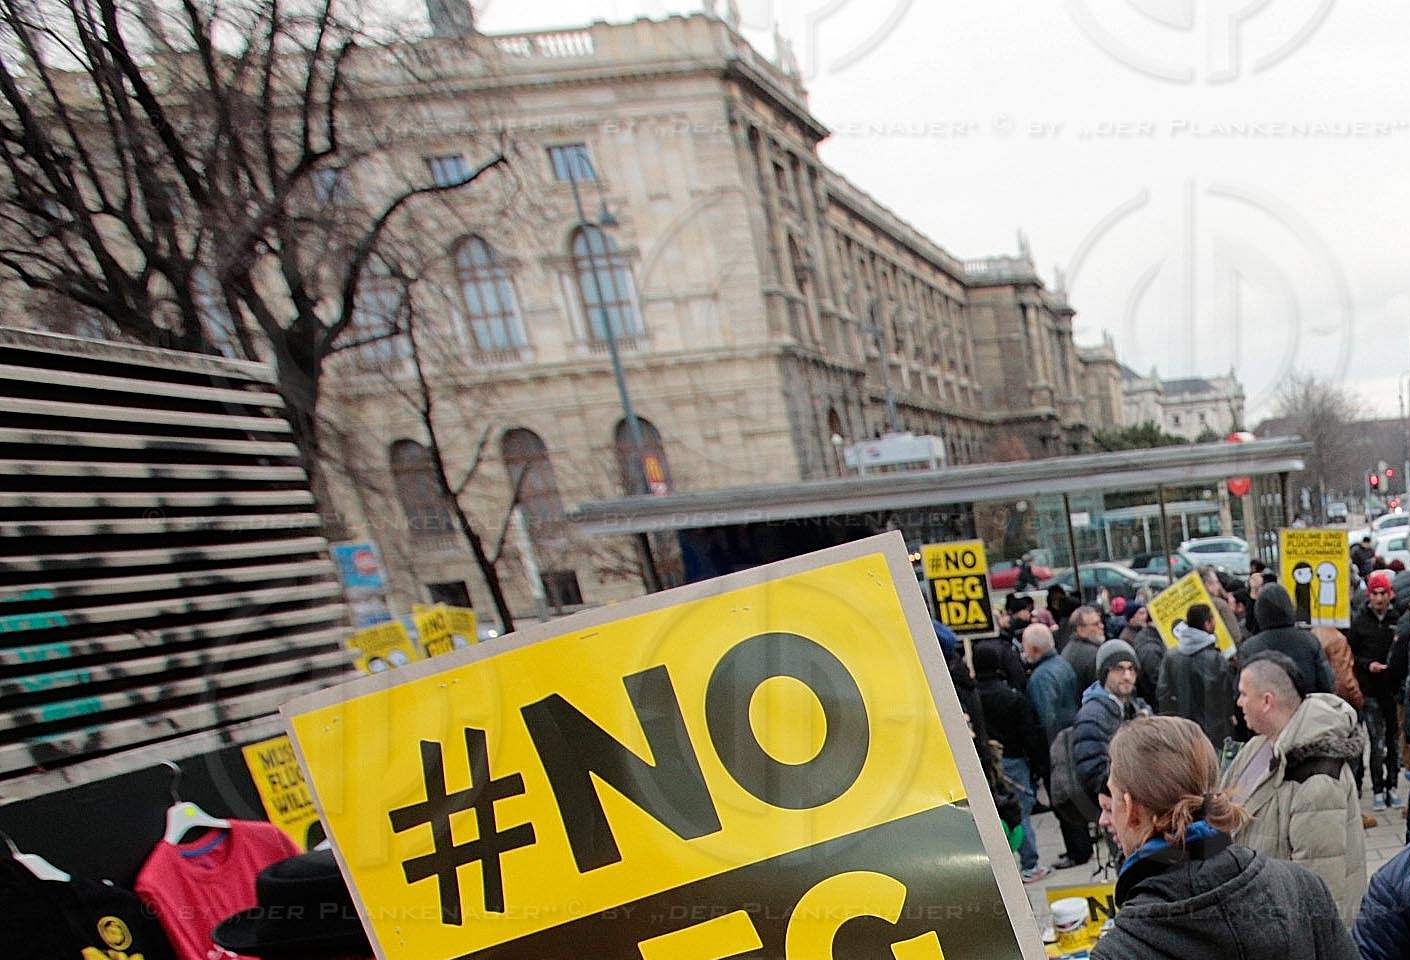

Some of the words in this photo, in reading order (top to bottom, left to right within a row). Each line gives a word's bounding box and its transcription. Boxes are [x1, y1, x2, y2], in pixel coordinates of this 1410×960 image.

[928, 550, 977, 572] #NO
[934, 575, 984, 602] PEG
[939, 599, 988, 626] IDA
[388, 631, 870, 926] #NO
